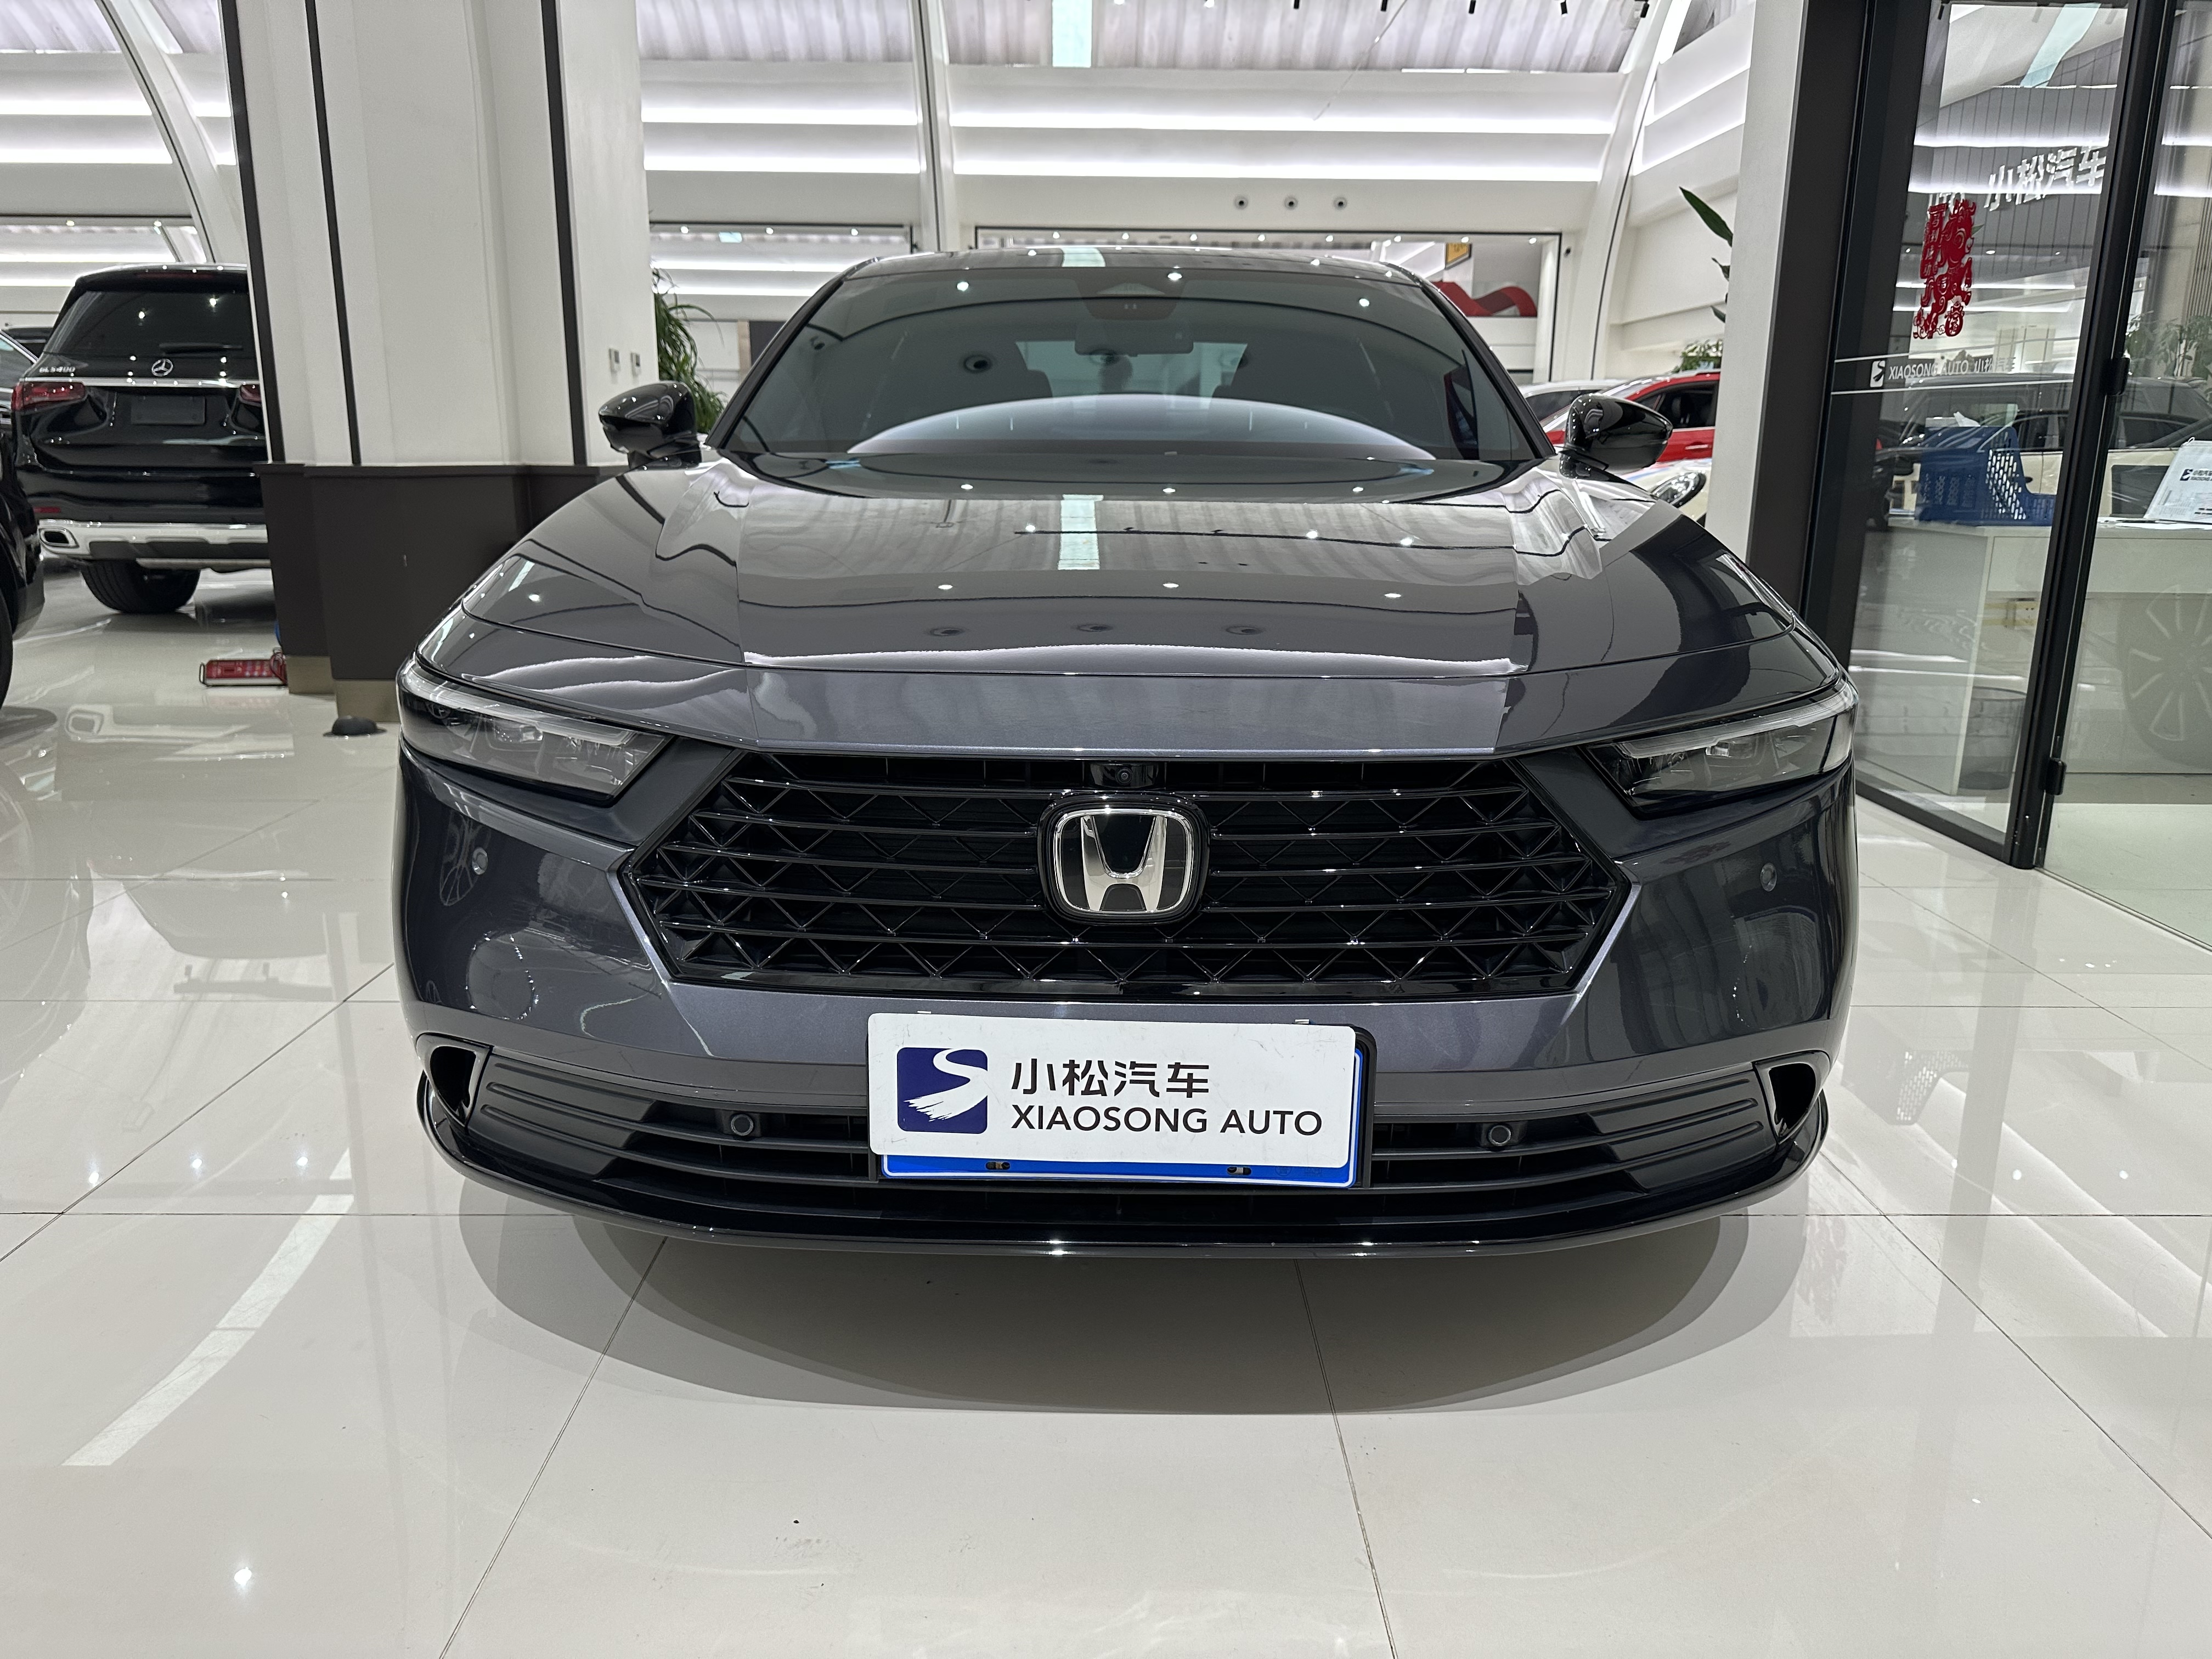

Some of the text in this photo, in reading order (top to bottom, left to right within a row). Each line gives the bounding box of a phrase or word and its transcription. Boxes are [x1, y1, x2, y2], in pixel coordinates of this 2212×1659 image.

[1888, 359, 1968, 380] XIAOSONG AUTO
[1011, 1058, 1209, 1098] 小松汽车
[1011, 1104, 1322, 1136] XIAOSONG AUTO
